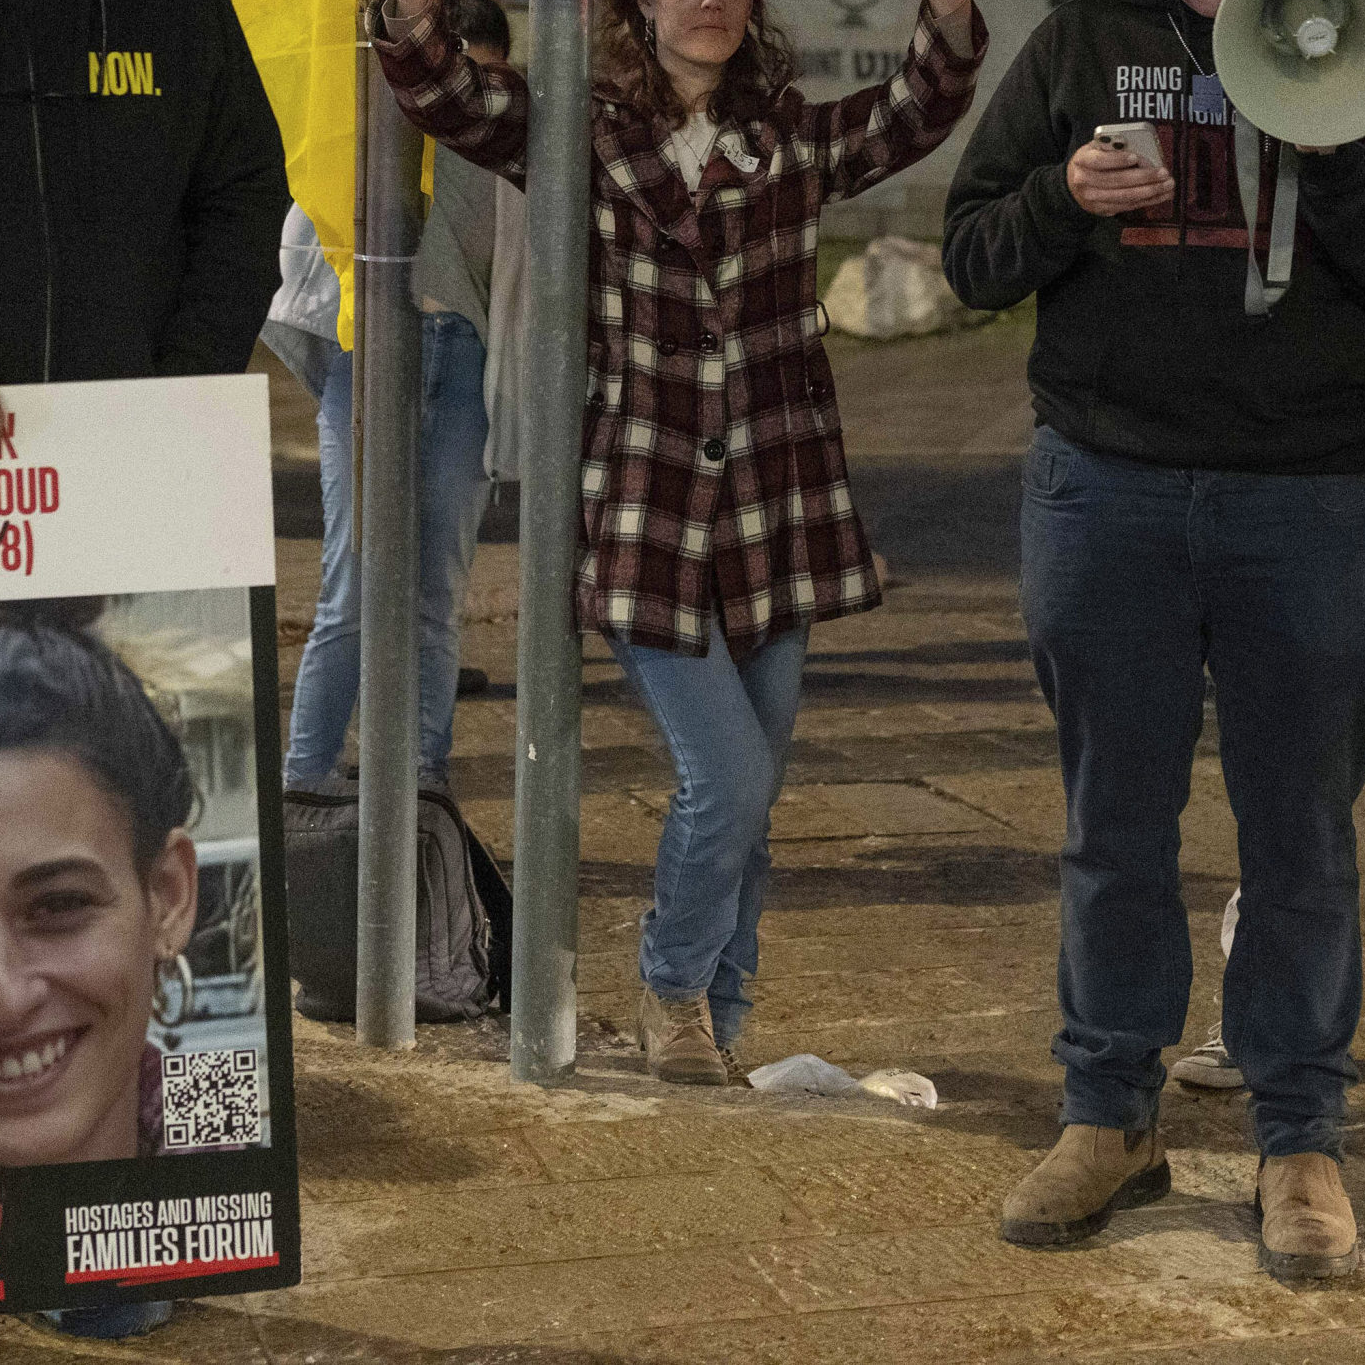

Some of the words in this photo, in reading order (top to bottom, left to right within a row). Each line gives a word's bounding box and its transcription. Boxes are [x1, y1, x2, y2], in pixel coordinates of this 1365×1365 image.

[88, 51, 162, 96] NOW.
[1116, 66, 1182, 91] BRING
[1116, 92, 1174, 120] THEM
[65, 1201, 154, 1234] HOSTAGES
[157, 1198, 192, 1227] AND
[195, 1192, 272, 1223] MISSING
[66, 1227, 179, 1274] FAMILIES
[185, 1219, 274, 1264] FORUM
